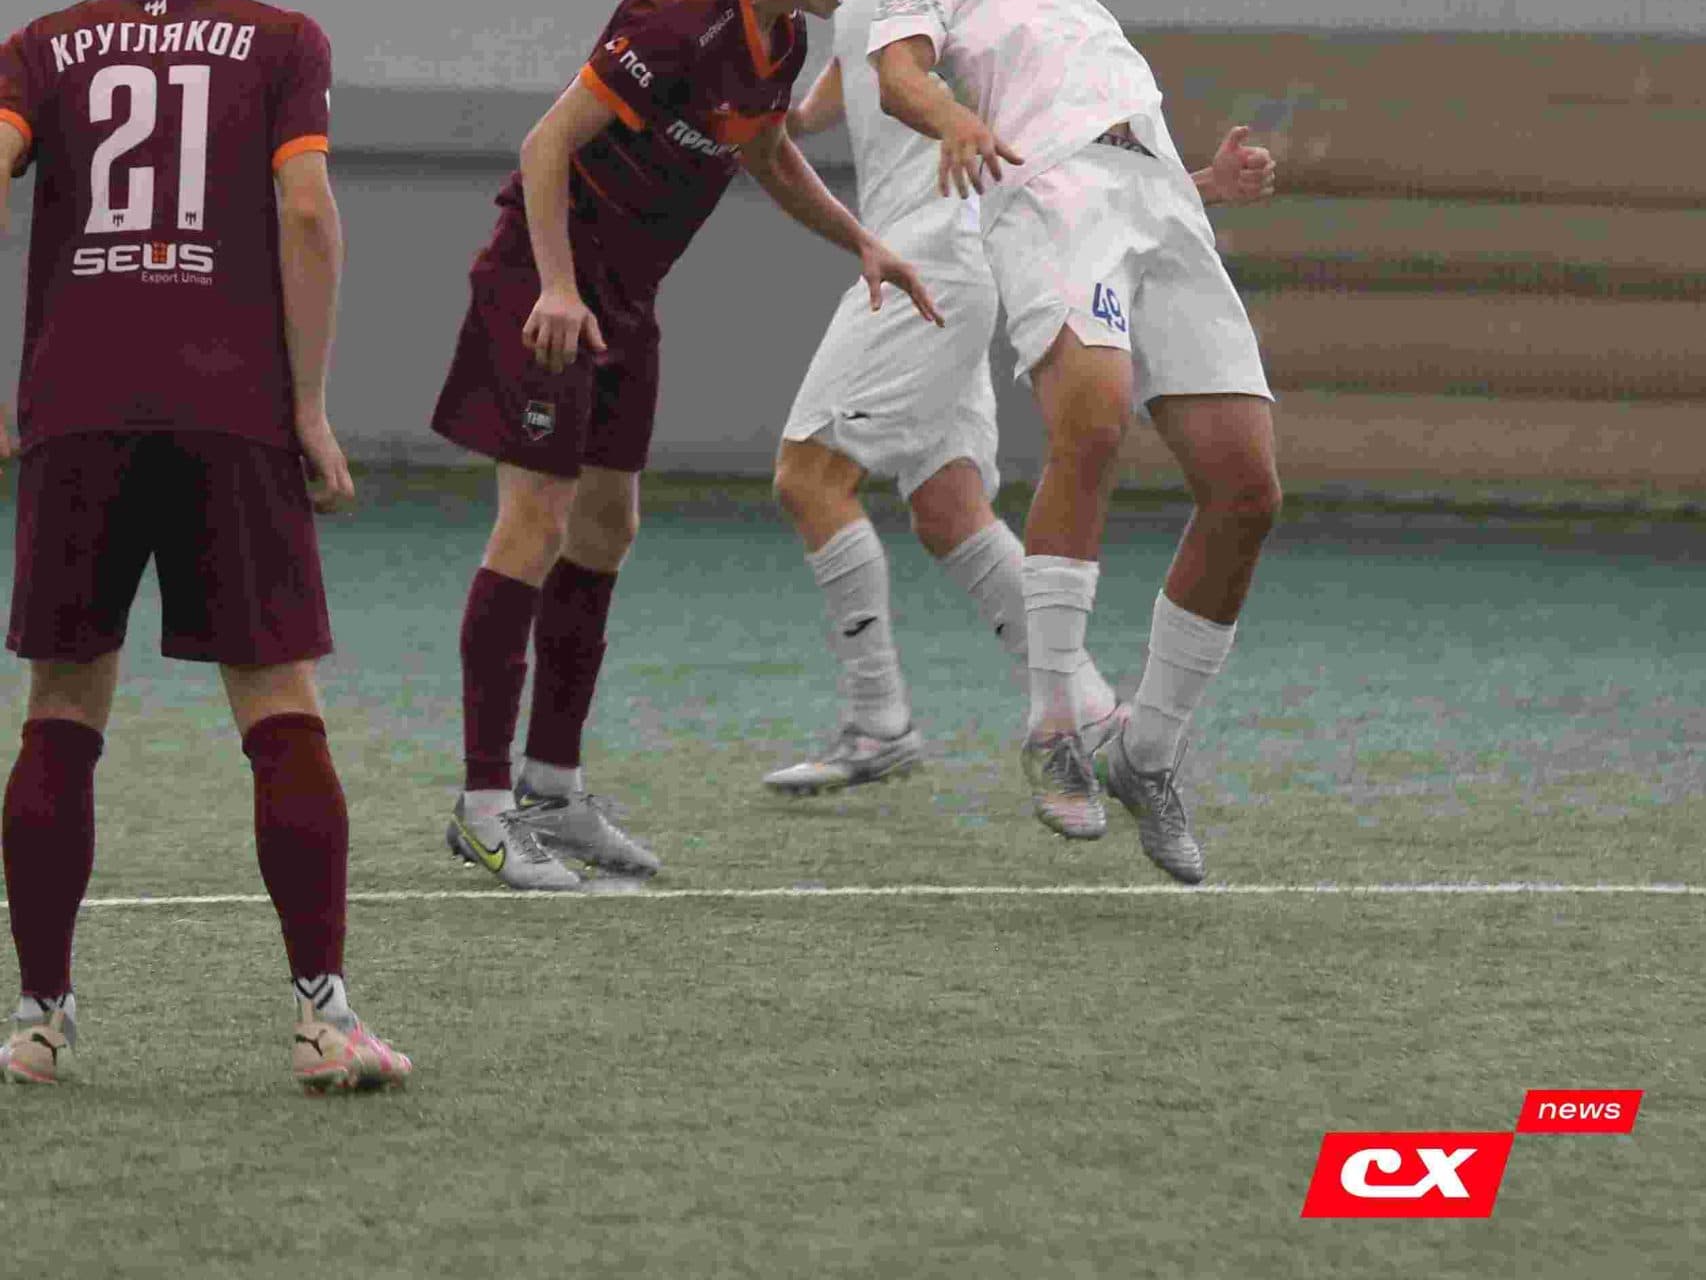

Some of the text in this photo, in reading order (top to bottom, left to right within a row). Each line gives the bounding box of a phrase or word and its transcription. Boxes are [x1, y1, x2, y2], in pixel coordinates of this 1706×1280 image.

[50, 20, 256, 72] КРУГЛЯКОВ
[84, 64, 212, 235] 21
[71, 242, 215, 276] SEUS
[141, 271, 178, 284] Export
[1092, 282, 1126, 333] 49
